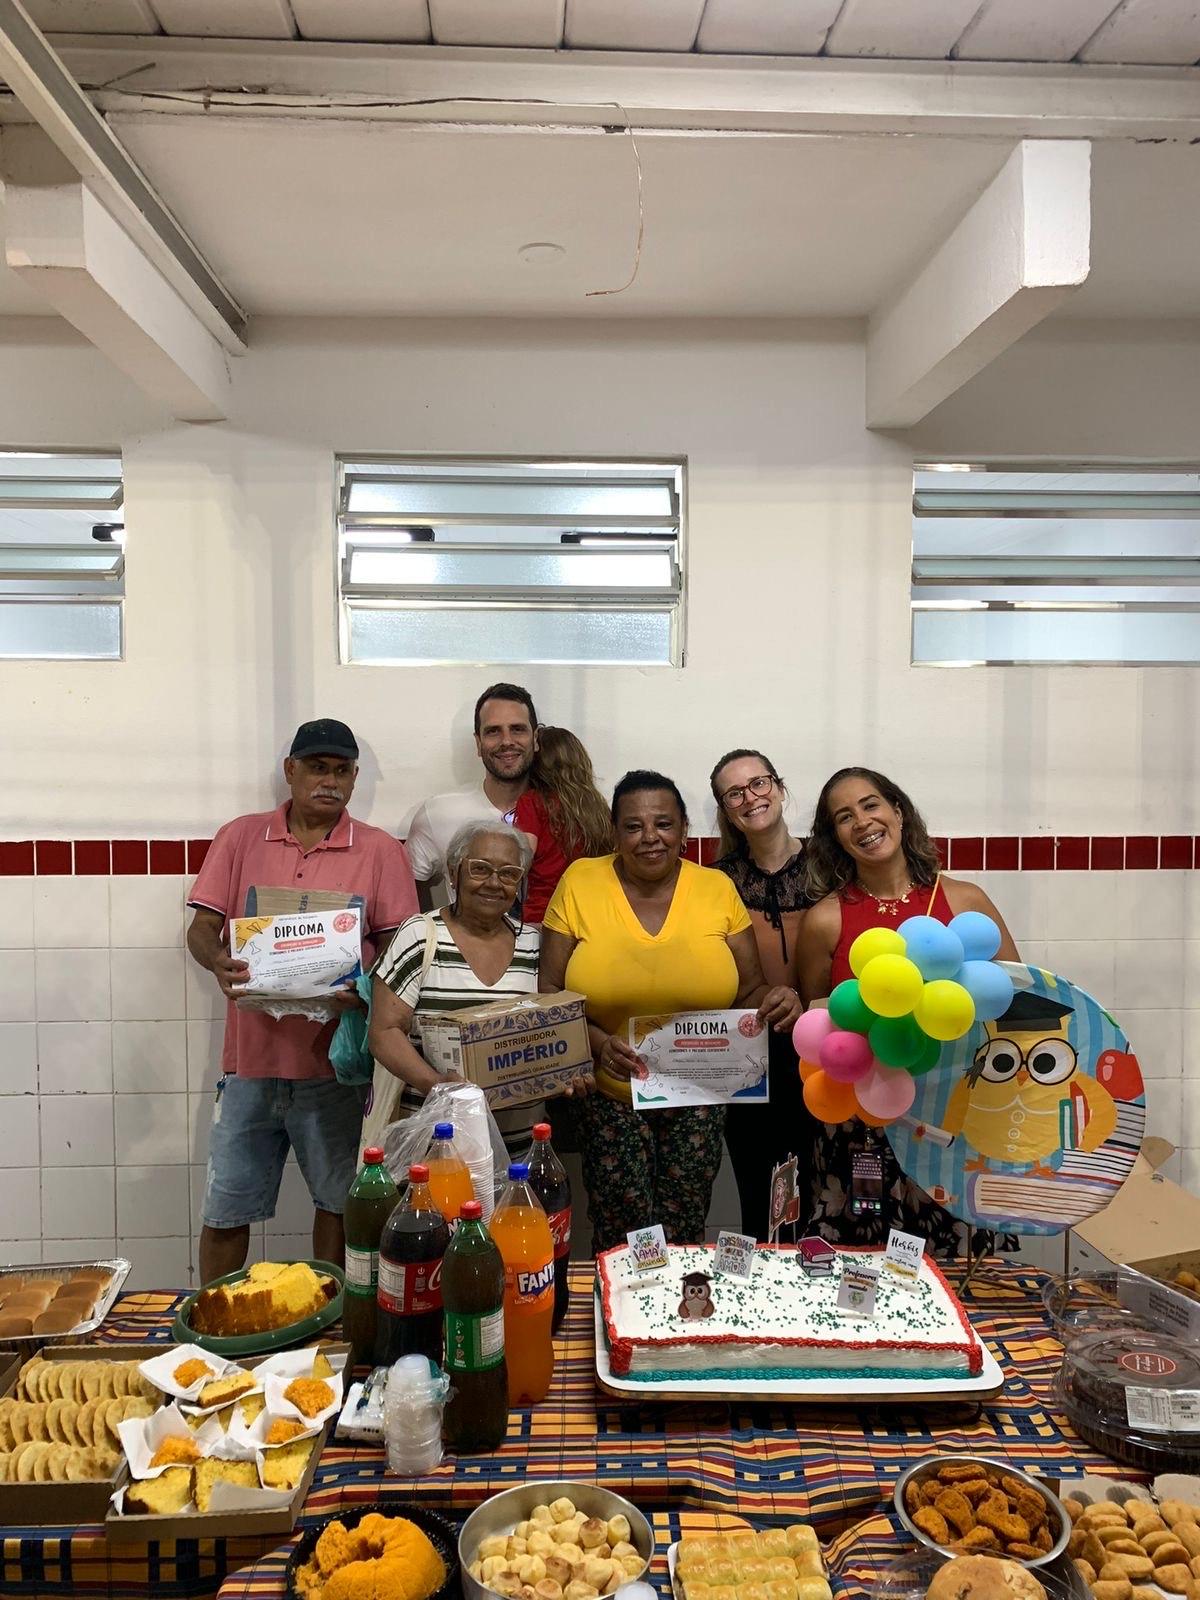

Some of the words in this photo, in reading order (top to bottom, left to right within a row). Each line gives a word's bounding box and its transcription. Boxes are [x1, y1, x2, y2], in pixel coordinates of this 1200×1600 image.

[274, 922, 325, 939] DIPLOMA
[675, 1021, 728, 1035] DIPLOMA
[494, 1029, 557, 1050] DISTRIBUIDORA
[487, 1040, 568, 1072] IMPÉRIO
[638, 1248, 659, 1260] AMA
[716, 1258, 747, 1276] AMOR
[518, 1260, 555, 1293] FANT
